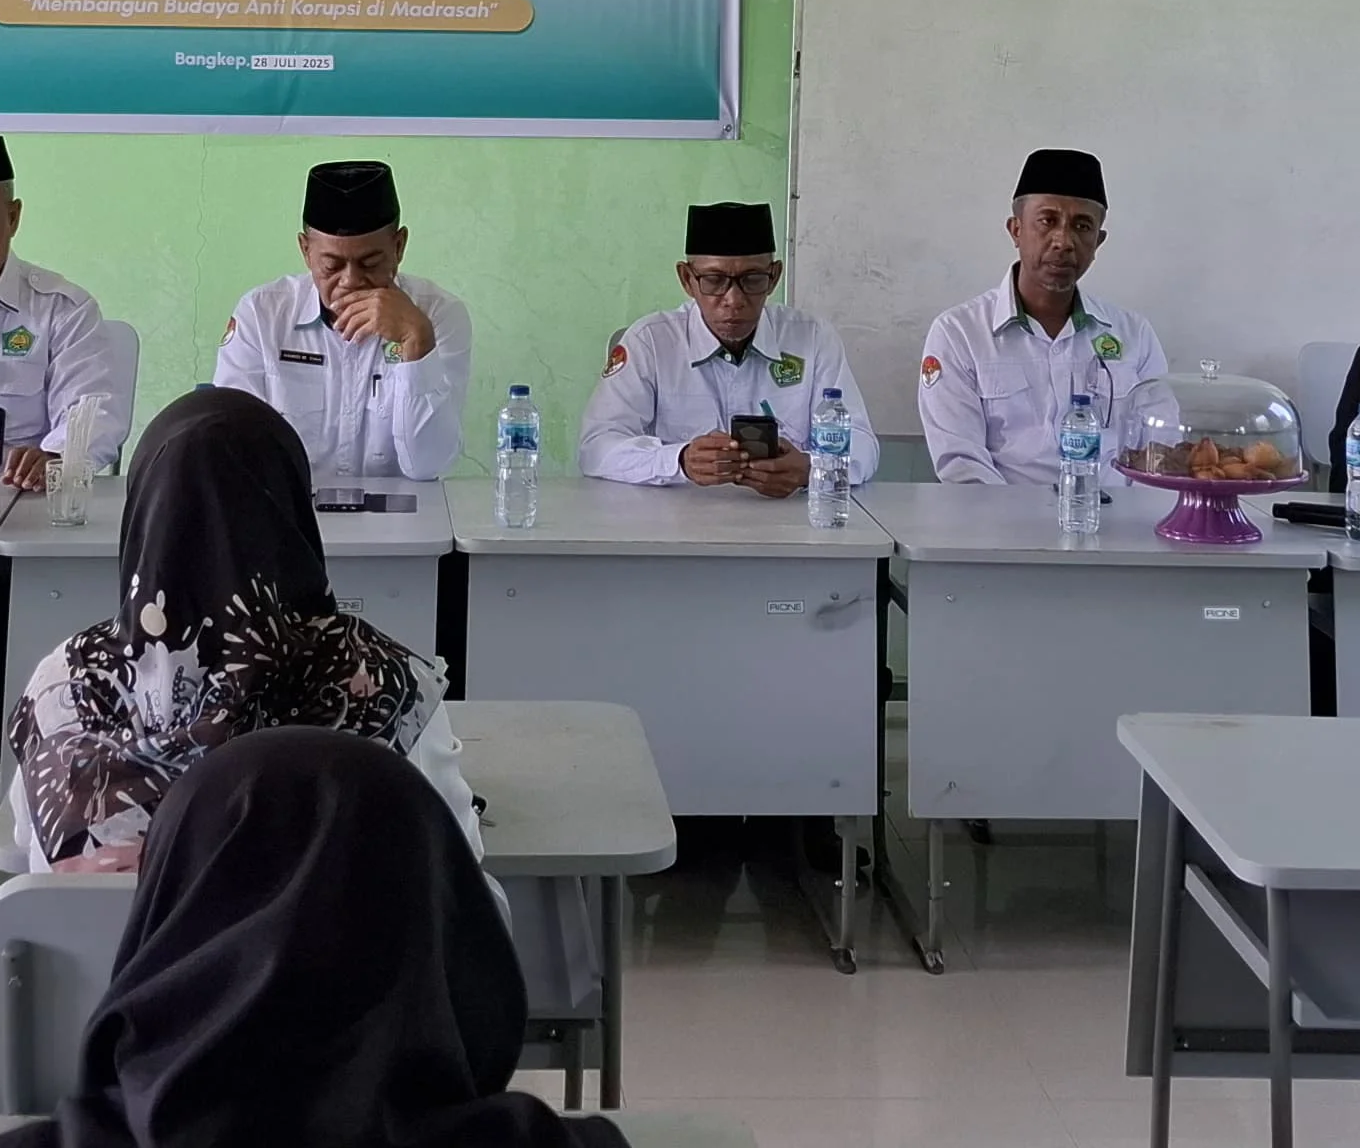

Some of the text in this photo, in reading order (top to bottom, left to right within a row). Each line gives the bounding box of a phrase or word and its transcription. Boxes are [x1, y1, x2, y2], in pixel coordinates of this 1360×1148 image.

[290, 0, 361, 20] Korupsi
[366, 0, 385, 17] di
[254, 58, 268, 67] 28
[273, 58, 296, 68] JULI
[302, 58, 330, 69] 2025
[769, 603, 801, 612] RIONE
